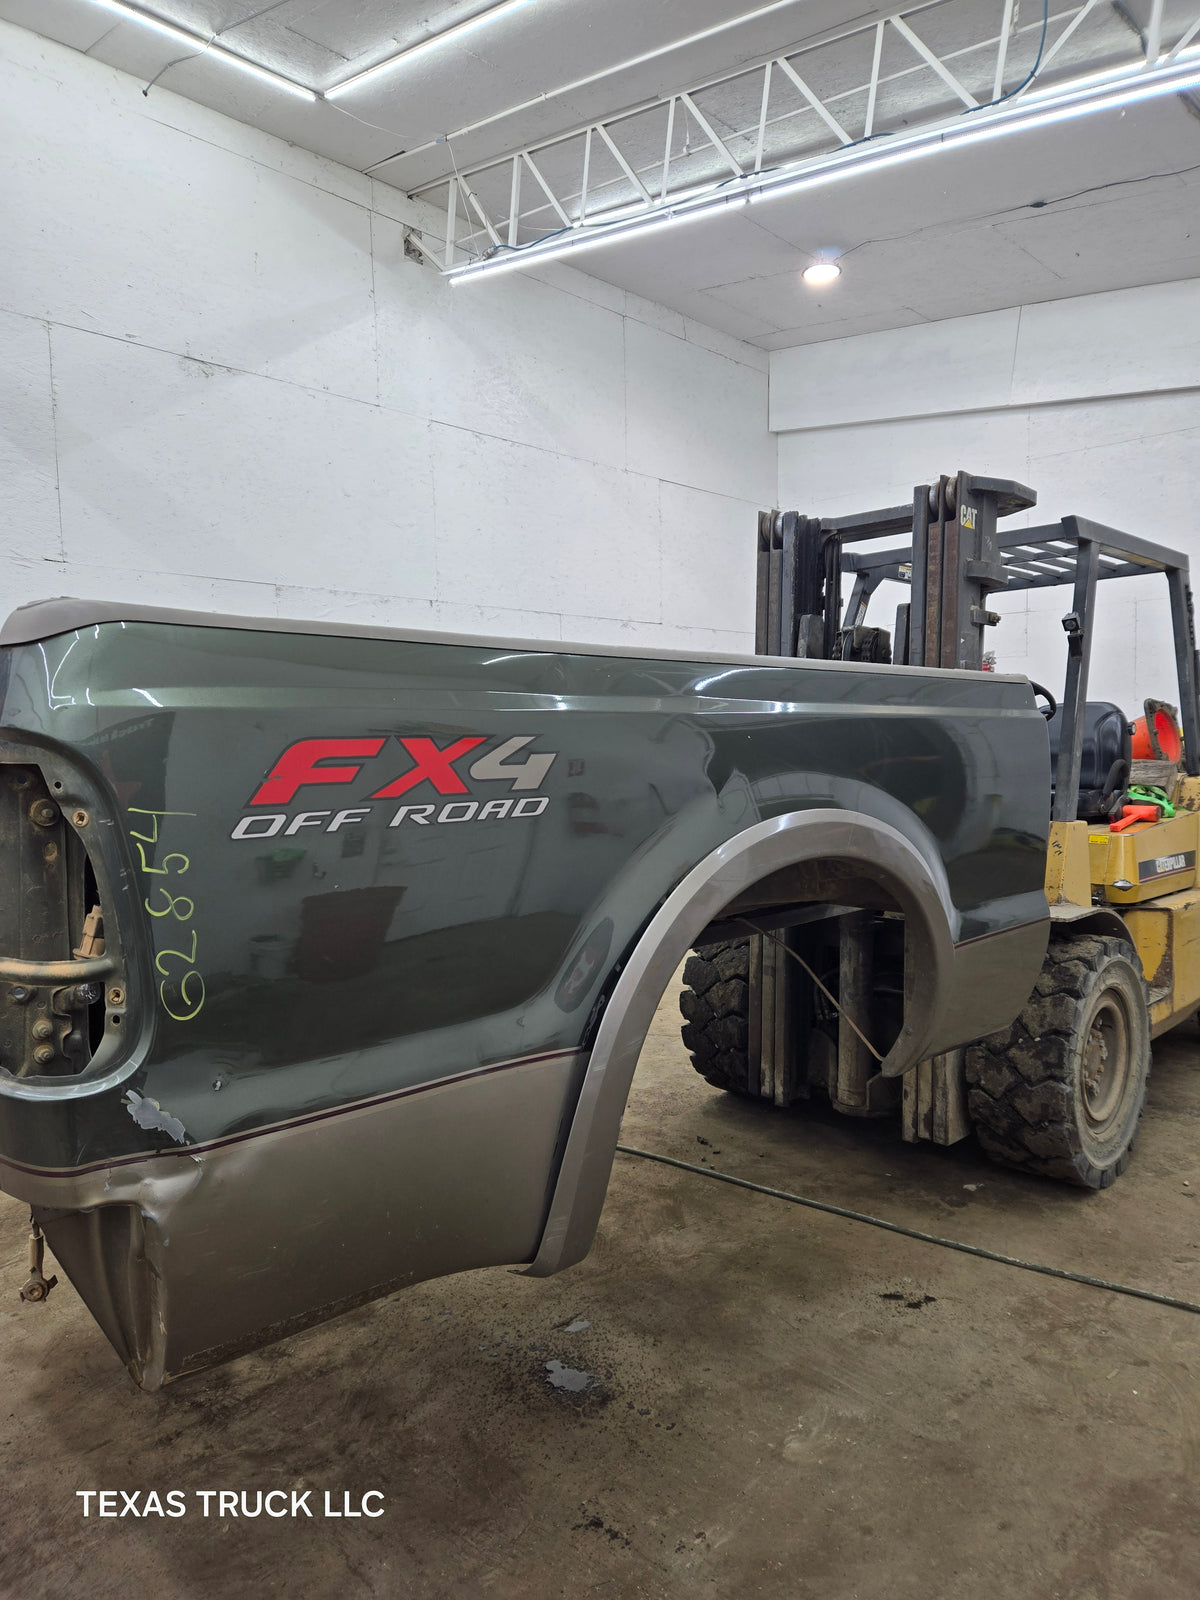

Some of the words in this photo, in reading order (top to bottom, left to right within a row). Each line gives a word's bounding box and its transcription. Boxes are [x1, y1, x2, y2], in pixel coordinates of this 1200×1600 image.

[960, 504, 978, 530] CAT
[246, 735, 557, 806] FX4
[231, 808, 371, 839] OFF
[390, 797, 549, 827] ROAD
[127, 807, 206, 1021] 62854
